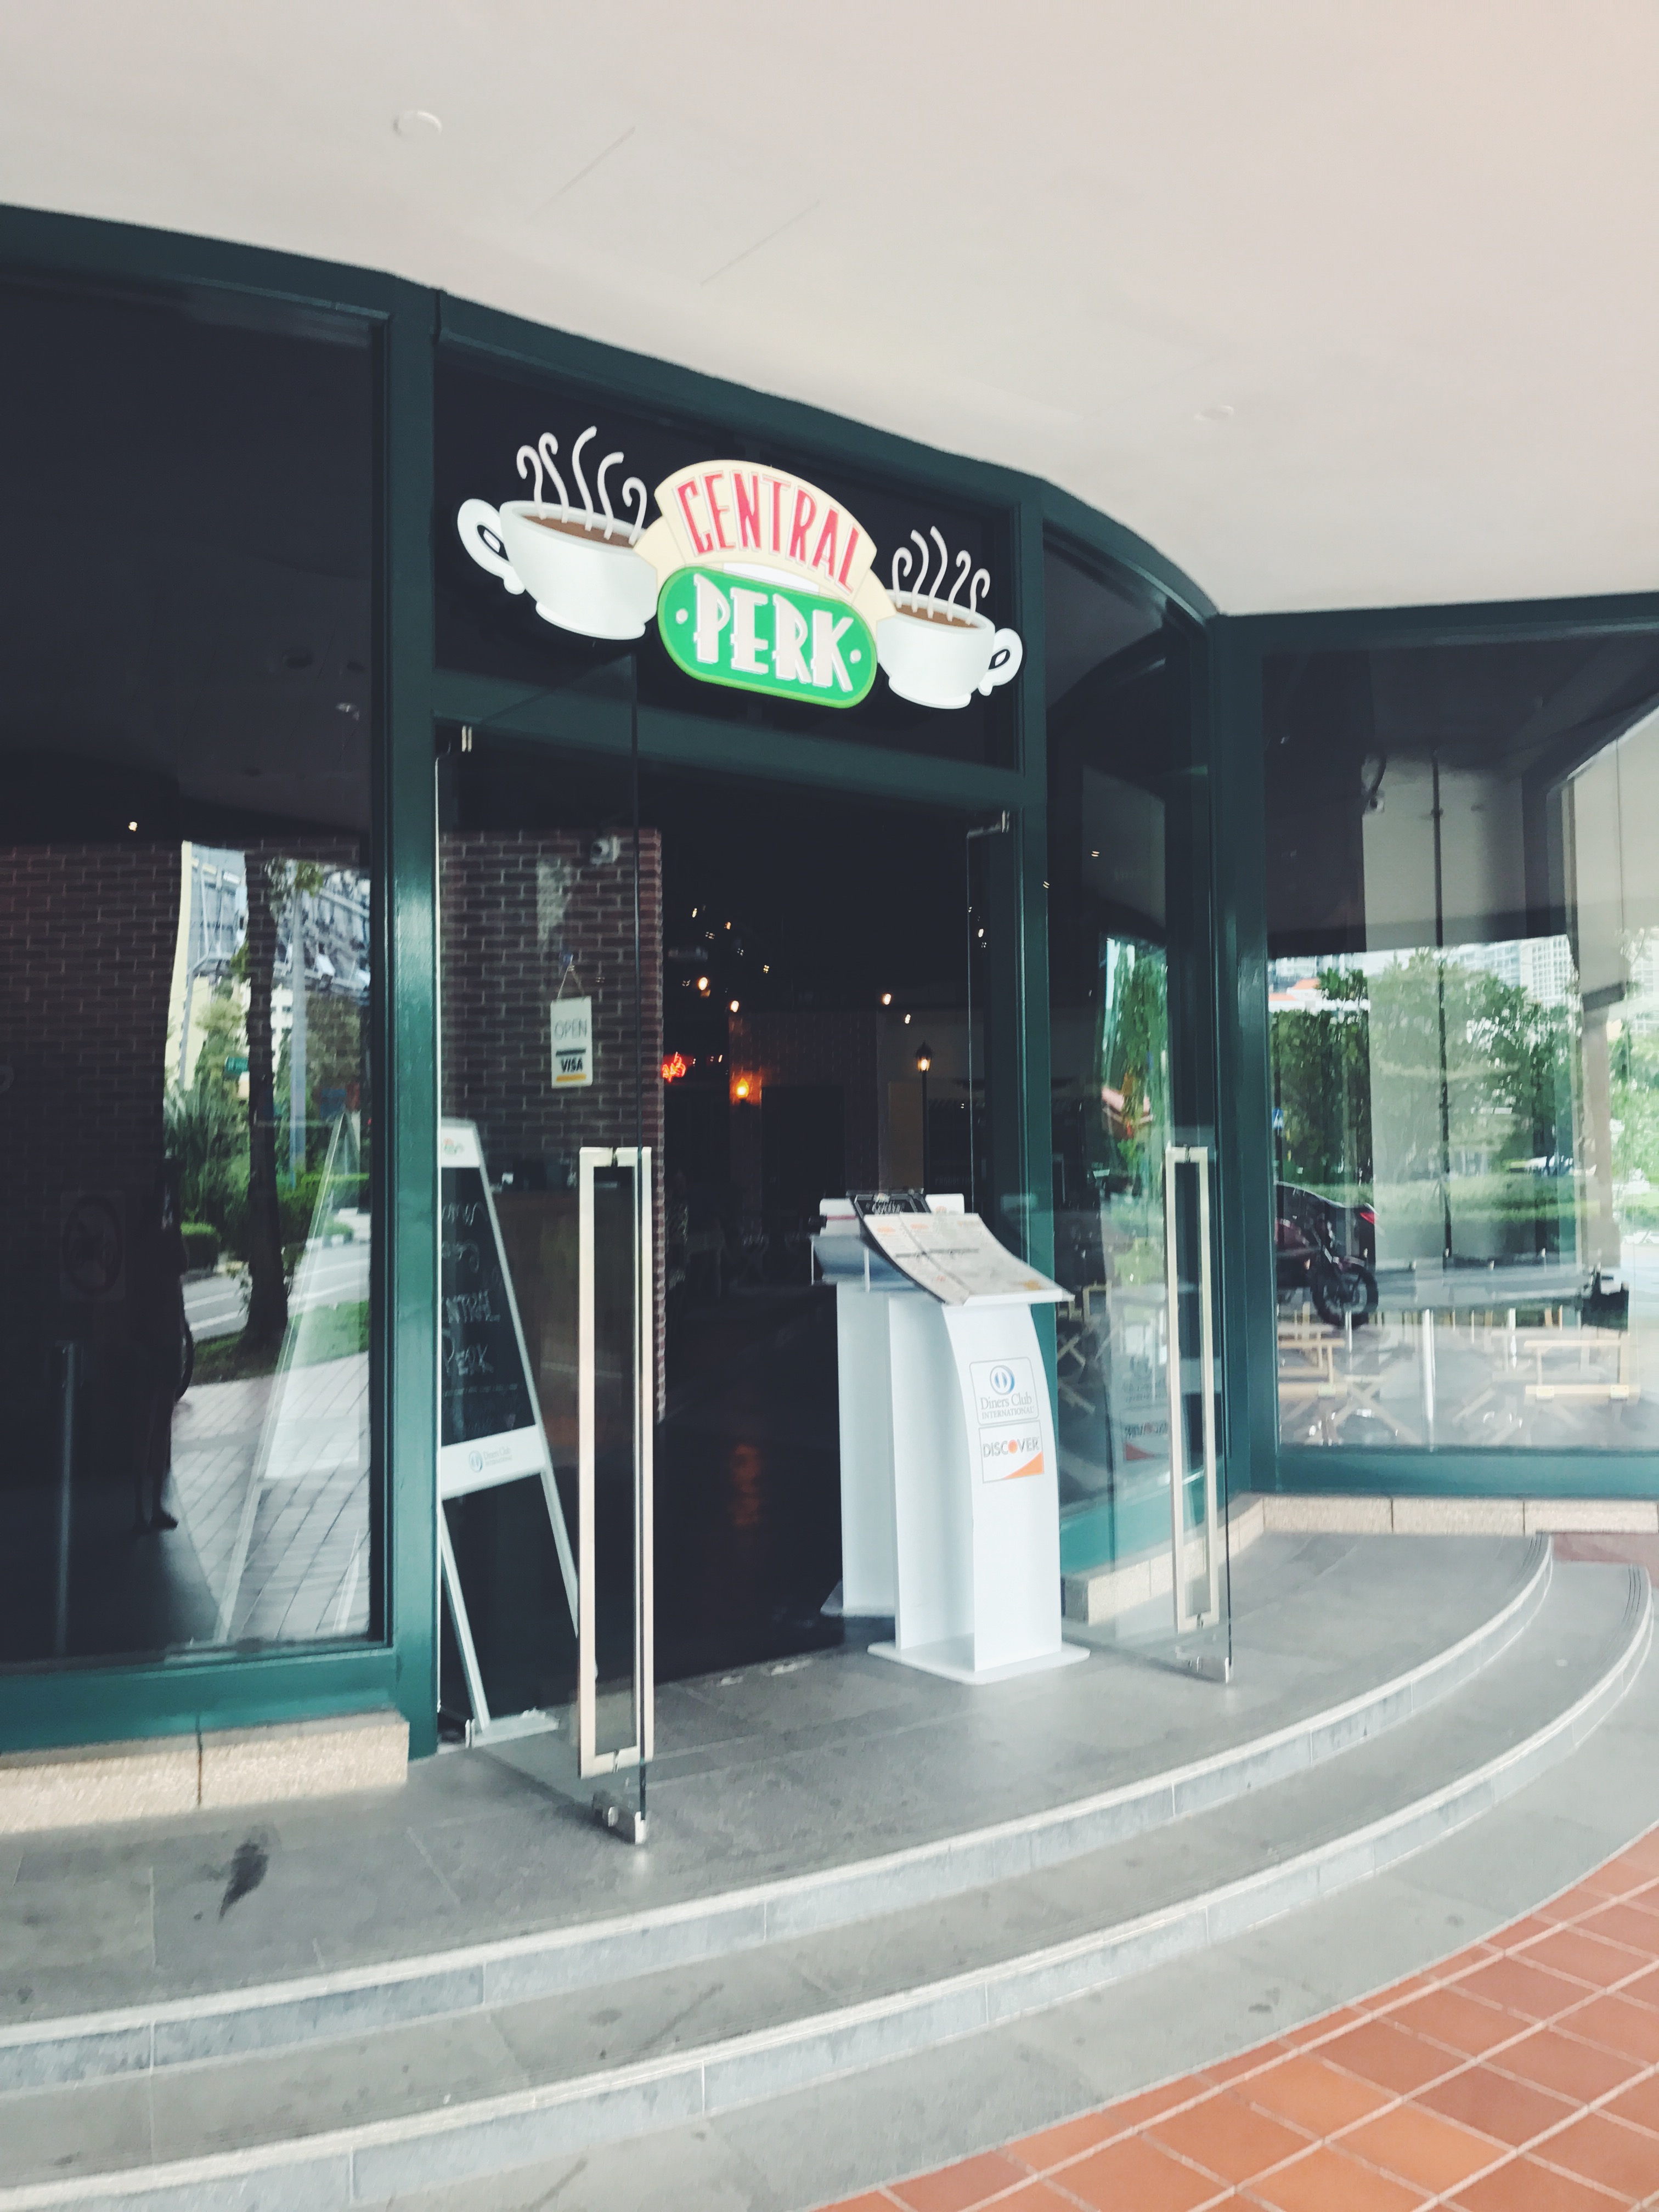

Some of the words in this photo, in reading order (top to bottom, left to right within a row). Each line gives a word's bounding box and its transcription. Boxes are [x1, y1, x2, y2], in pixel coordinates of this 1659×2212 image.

[675, 469, 860, 594] CENTRAL
[693, 573, 855, 692] PERK
[554, 1018, 588, 1040] OPEN
[561, 1057, 584, 1073] VISA
[980, 1396, 1010, 1410] Diners
[1011, 1391, 1032, 1406] Club
[981, 1406, 1034, 1420] INTERNATIONAL
[983, 1437, 1040, 1458] DISCOVER
